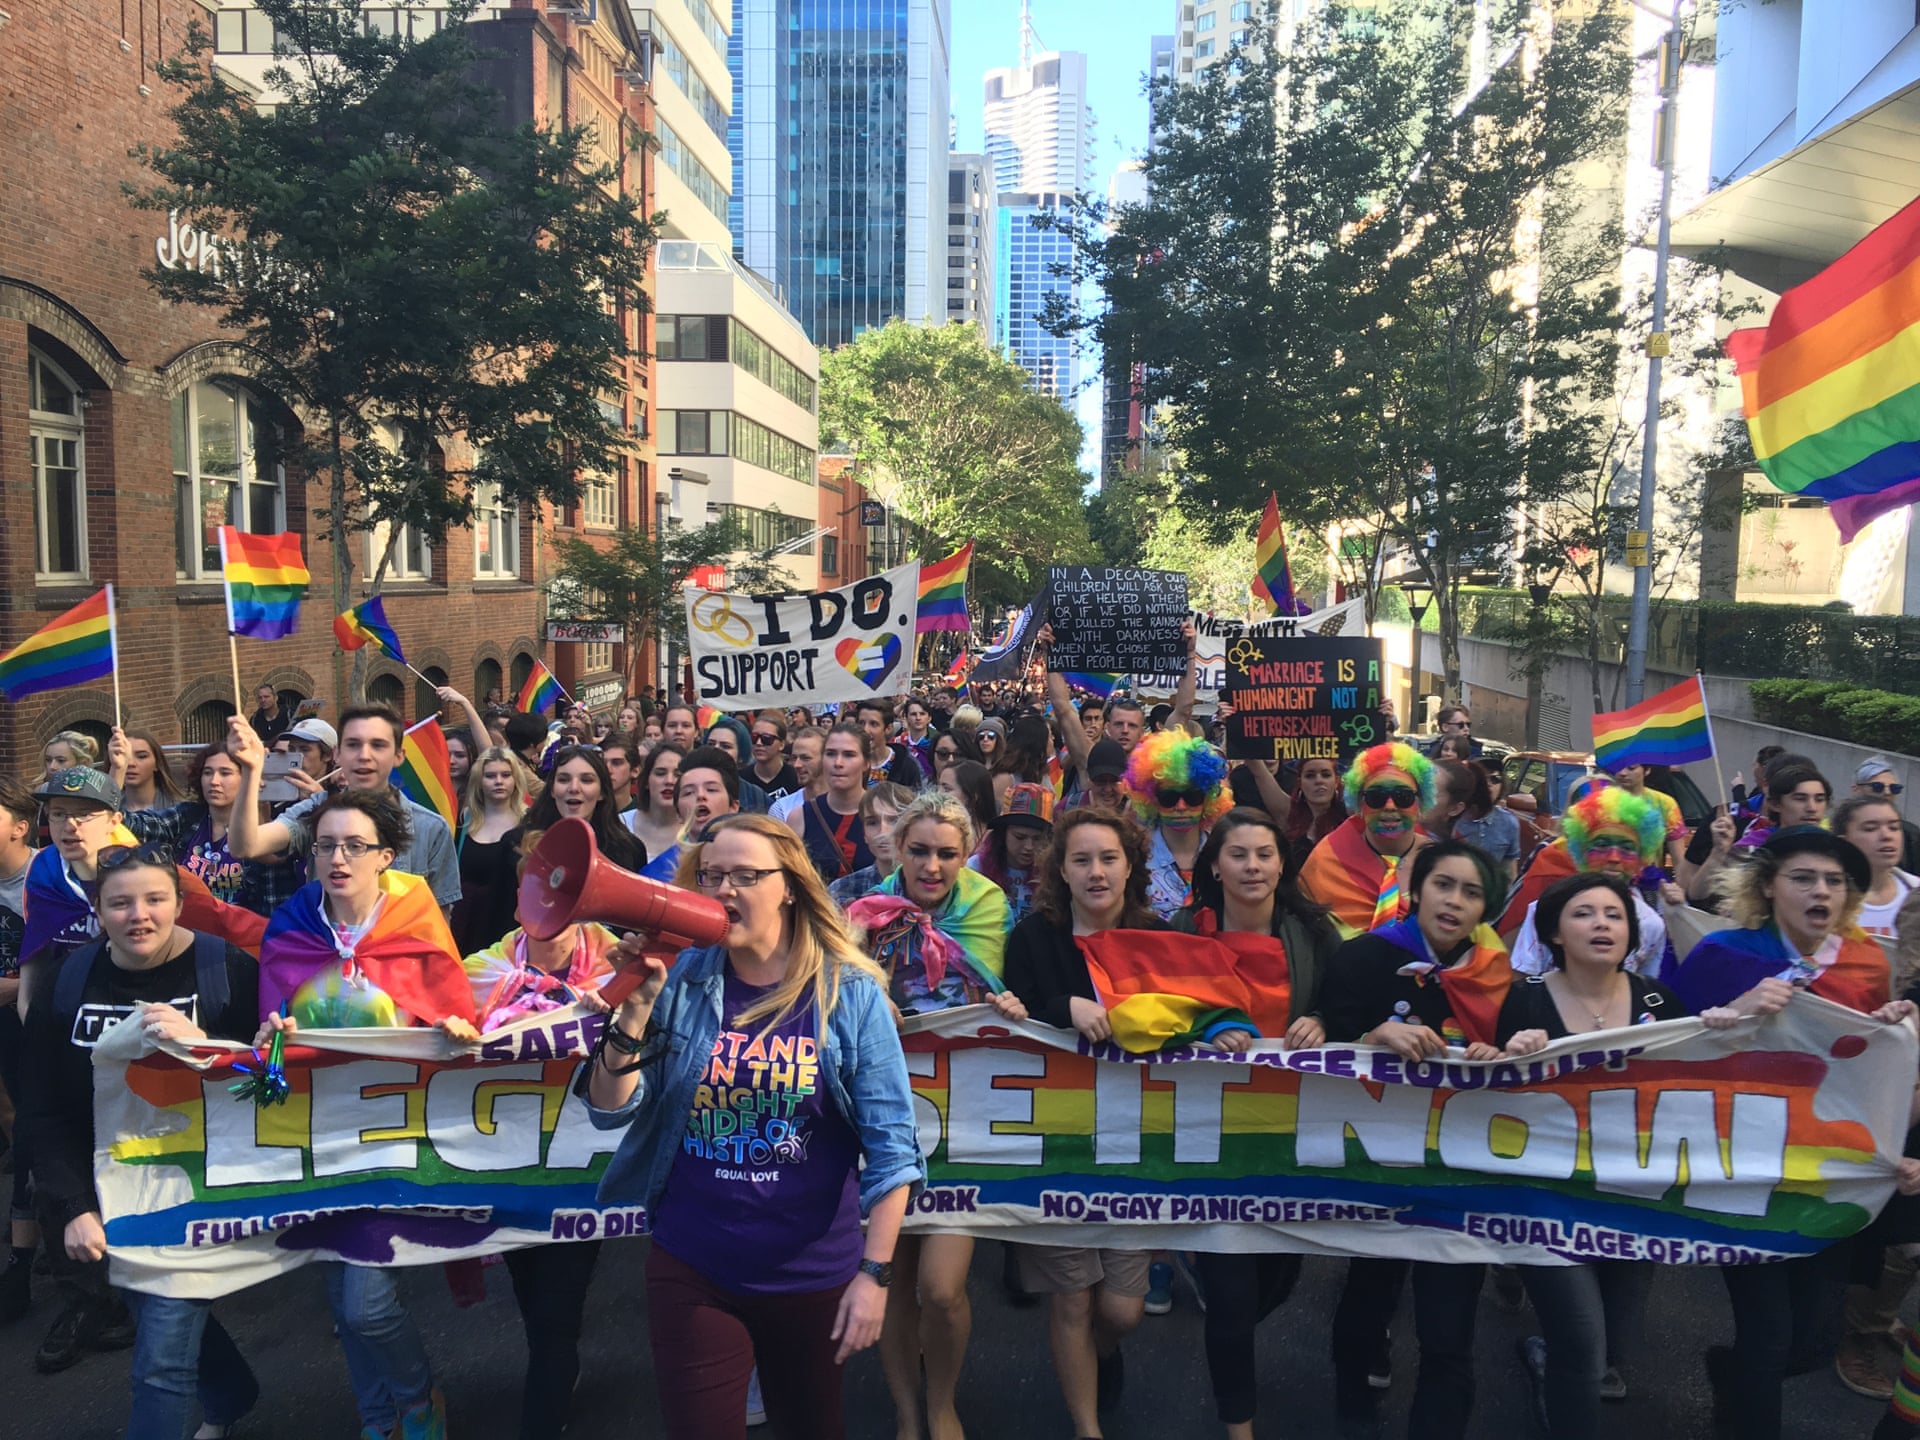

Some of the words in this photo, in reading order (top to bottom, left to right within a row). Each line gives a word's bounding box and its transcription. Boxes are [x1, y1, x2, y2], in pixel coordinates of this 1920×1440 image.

[1051, 567, 1067, 580] IN
[1080, 567, 1093, 580] A
[1105, 568, 1160, 582] DECADE
[1164, 572, 1187, 584] OUR
[1054, 581, 1110, 593] CHILDREN
[1115, 582, 1141, 592] WILL
[1143, 581, 1164, 593] ASK
[1169, 583, 1187, 593] US
[1052, 593, 1068, 606] IF
[1072, 593, 1090, 605] WE
[1096, 593, 1139, 604] HELPED
[1148, 593, 1187, 604] THEM
[1054, 606, 1073, 619] OR
[1080, 605, 1093, 618] IF
[1100, 606, 1118, 616] WE
[1122, 605, 1142, 615] DID
[1145, 603, 1190, 615] NOTHING
[751, 595, 792, 646] I
[1052, 618, 1069, 629] WE
[1075, 618, 1115, 629] DULLED
[1121, 618, 1144, 628] THE
[1248, 620, 1298, 638] WITH
[1072, 630, 1102, 642] WITH
[1115, 628, 1180, 641] DARKNESS
[1051, 643, 1086, 654] WHEN
[1093, 643, 1111, 654] WE
[1115, 643, 1152, 654] CHOSE
[1159, 643, 1177, 653] TO
[697, 648, 819, 699] SUPPORT
[1048, 655, 1081, 670] HATE
[1086, 655, 1127, 669] PEOPLE
[1132, 656, 1150, 669] FOR
[1153, 655, 1187, 672] LOVING
[1249, 661, 1325, 685] MARRIAGE
[1337, 659, 1356, 683] IS
[1367, 660, 1380, 682] A
[1331, 687, 1359, 710] NOT
[1366, 687, 1379, 709] A
[1243, 715, 1336, 738] HETROSEXUAL
[1274, 737, 1340, 760] PRIVILEGE
[747, 1060, 819, 1096] THE
[693, 1084, 804, 1118] RIGHT
[685, 1108, 760, 1137] SIDE
[765, 1115, 811, 1145] OF
[1094, 1057, 1252, 1166] IT
[1295, 1073, 1789, 1218] NOW
[683, 1130, 813, 1166] HISTORY
[715, 1168, 750, 1182] EQUAL
[751, 1170, 780, 1183] LOVE
[1043, 1193, 1085, 1219] NO
[192, 1219, 259, 1247] FULL
[551, 1212, 598, 1240] NO
[1467, 1214, 1567, 1248] EQUAL
[1574, 1227, 1637, 1258] AGE
[1646, 1238, 1685, 1265] OF
